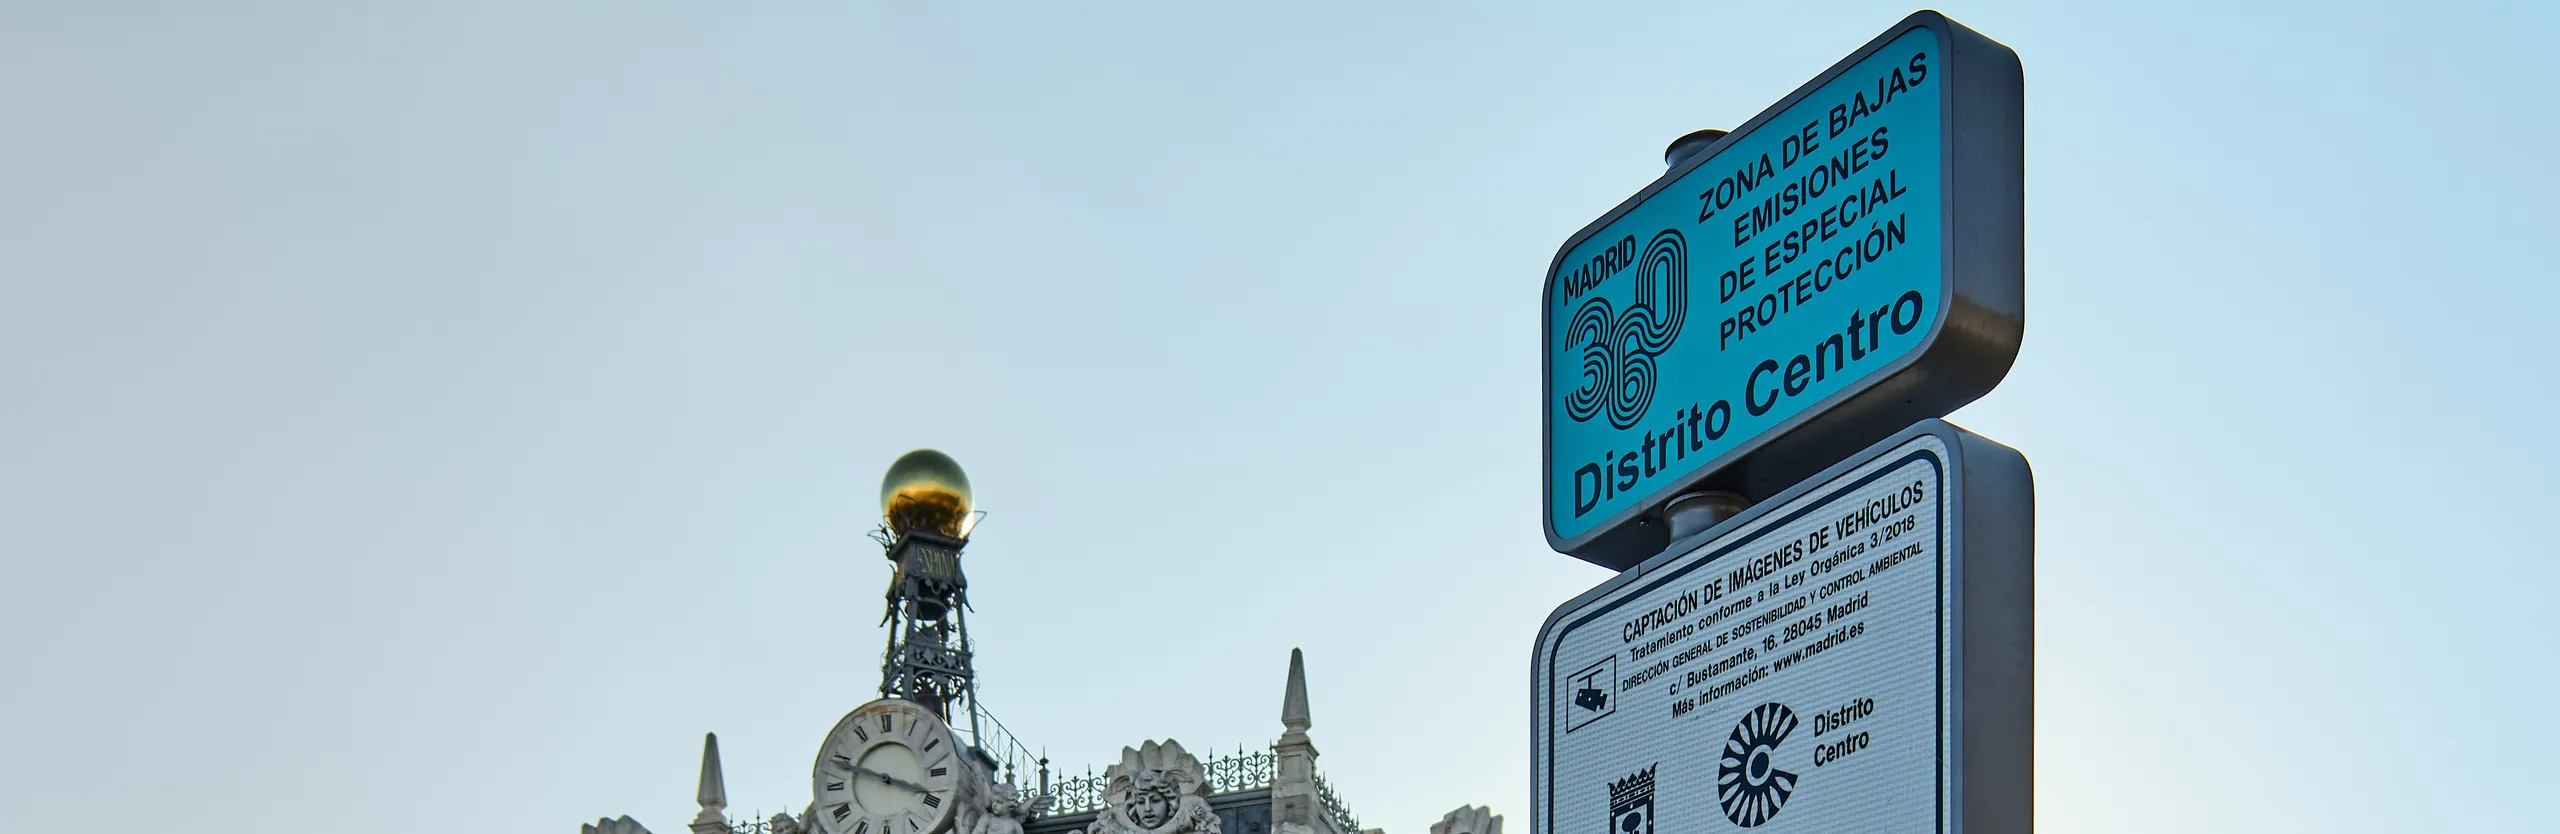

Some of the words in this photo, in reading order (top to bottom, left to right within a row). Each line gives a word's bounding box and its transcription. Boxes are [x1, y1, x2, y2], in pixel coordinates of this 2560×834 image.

[1698, 152, 1775, 225] ZONA
[1782, 119, 1820, 170] DE
[1829, 52, 1927, 140] BAJAS
[1734, 126, 1889, 248] EMISIONES
[1563, 234, 1636, 307] MADRID
[1720, 256, 1756, 304] DE
[1765, 169, 1907, 277] ESPECIAL
[1720, 212, 1906, 352] PROTECCIÓN
[1574, 399, 1731, 519] Distrito
[1745, 290, 1923, 417] Centro
[1622, 659, 1670, 692] DIRECCIÓN
[1672, 639, 1713, 668] GENERAL
[1716, 632, 1729, 648] DE
[1732, 596, 1807, 640] SOSTENIBILIDAD
[1810, 590, 1816, 604] Y
[1819, 568, 1865, 600] CONTROL
[1868, 541, 1924, 578] AMBIENTAL
[1623, 590, 1698, 643] CAPTACIÓN
[1703, 578, 1723, 605] DE
[1728, 539, 1803, 594] IMÁGENES
[1809, 526, 1829, 554] DE
[1836, 480, 1923, 540] VEHÍCULOS
[1630, 624, 1694, 662] Tratamiento
[1698, 596, 1752, 630] conforme
[1757, 590, 1764, 602] a
[1769, 582, 1779, 596] la
[1784, 570, 1806, 589] Ley
[1810, 542, 1865, 577] Orgánica
[1870, 514, 1915, 549] 3/2018
[1669, 675, 1683, 696] c/
[1687, 646, 1758, 688] Bustamante,
[1783, 612, 1822, 644] 28045
[1827, 591, 1869, 624] Madrid
[1672, 698, 1695, 718] Más
[1699, 665, 1769, 706] información:
[1773, 621, 1865, 672] www.madrid.es
[1814, 697, 1874, 738] Distrito
[1814, 731, 1869, 767] Centro
